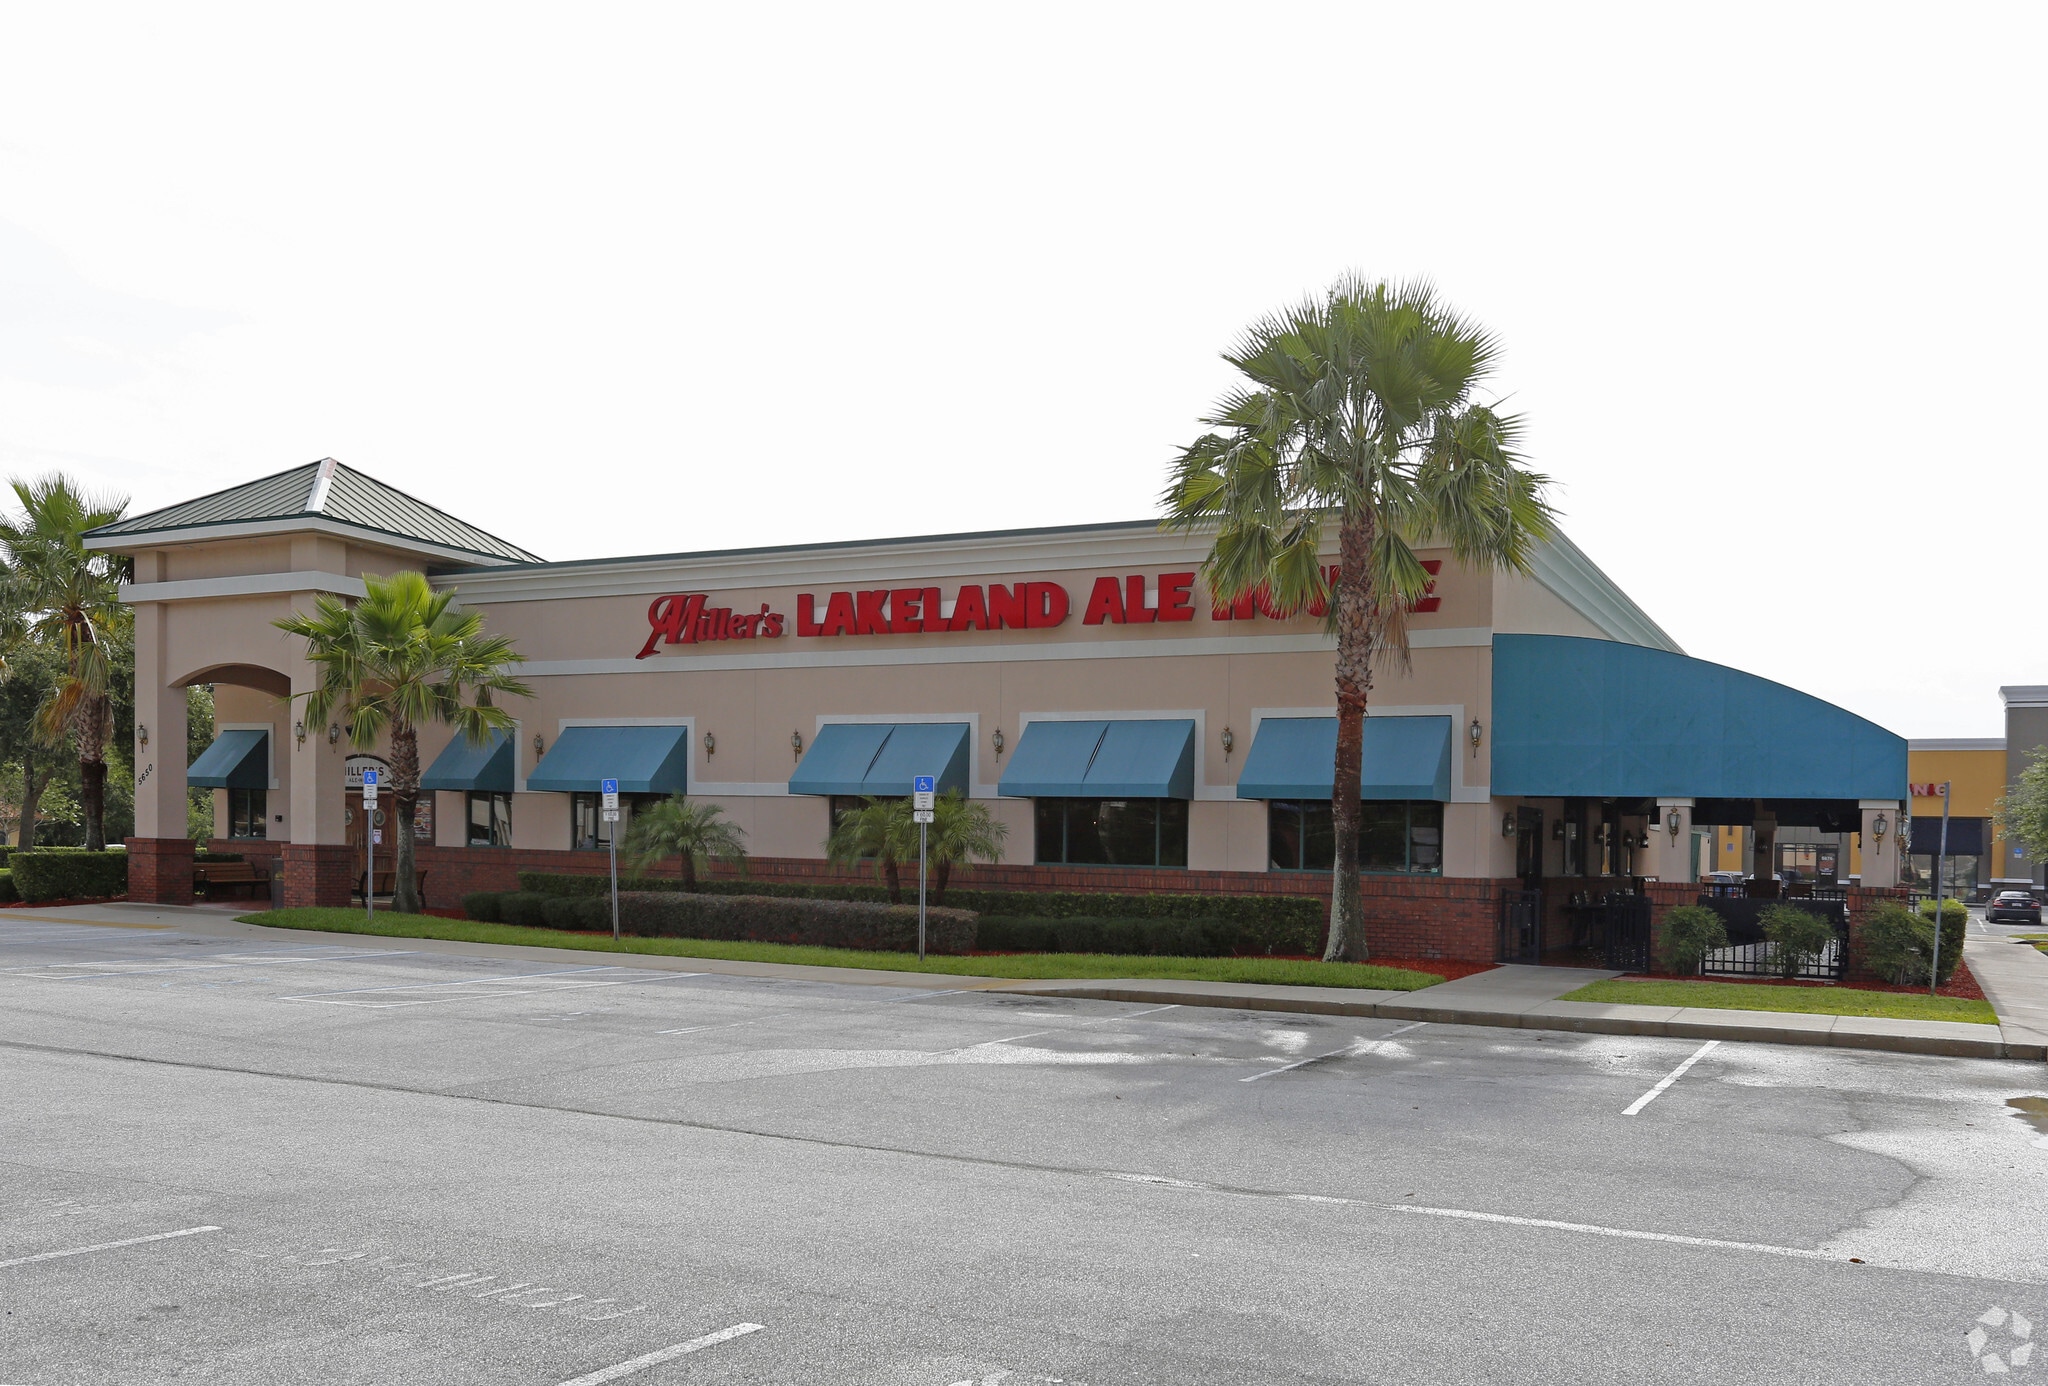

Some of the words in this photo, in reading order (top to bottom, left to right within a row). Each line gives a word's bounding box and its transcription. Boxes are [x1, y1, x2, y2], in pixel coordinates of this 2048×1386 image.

[636, 594, 783, 659] Miller's
[797, 581, 1069, 638] LAKELAND
[1083, 571, 1195, 625] ALE
[1211, 560, 1442, 621] HOUE
[138, 764, 152, 785] 5650
